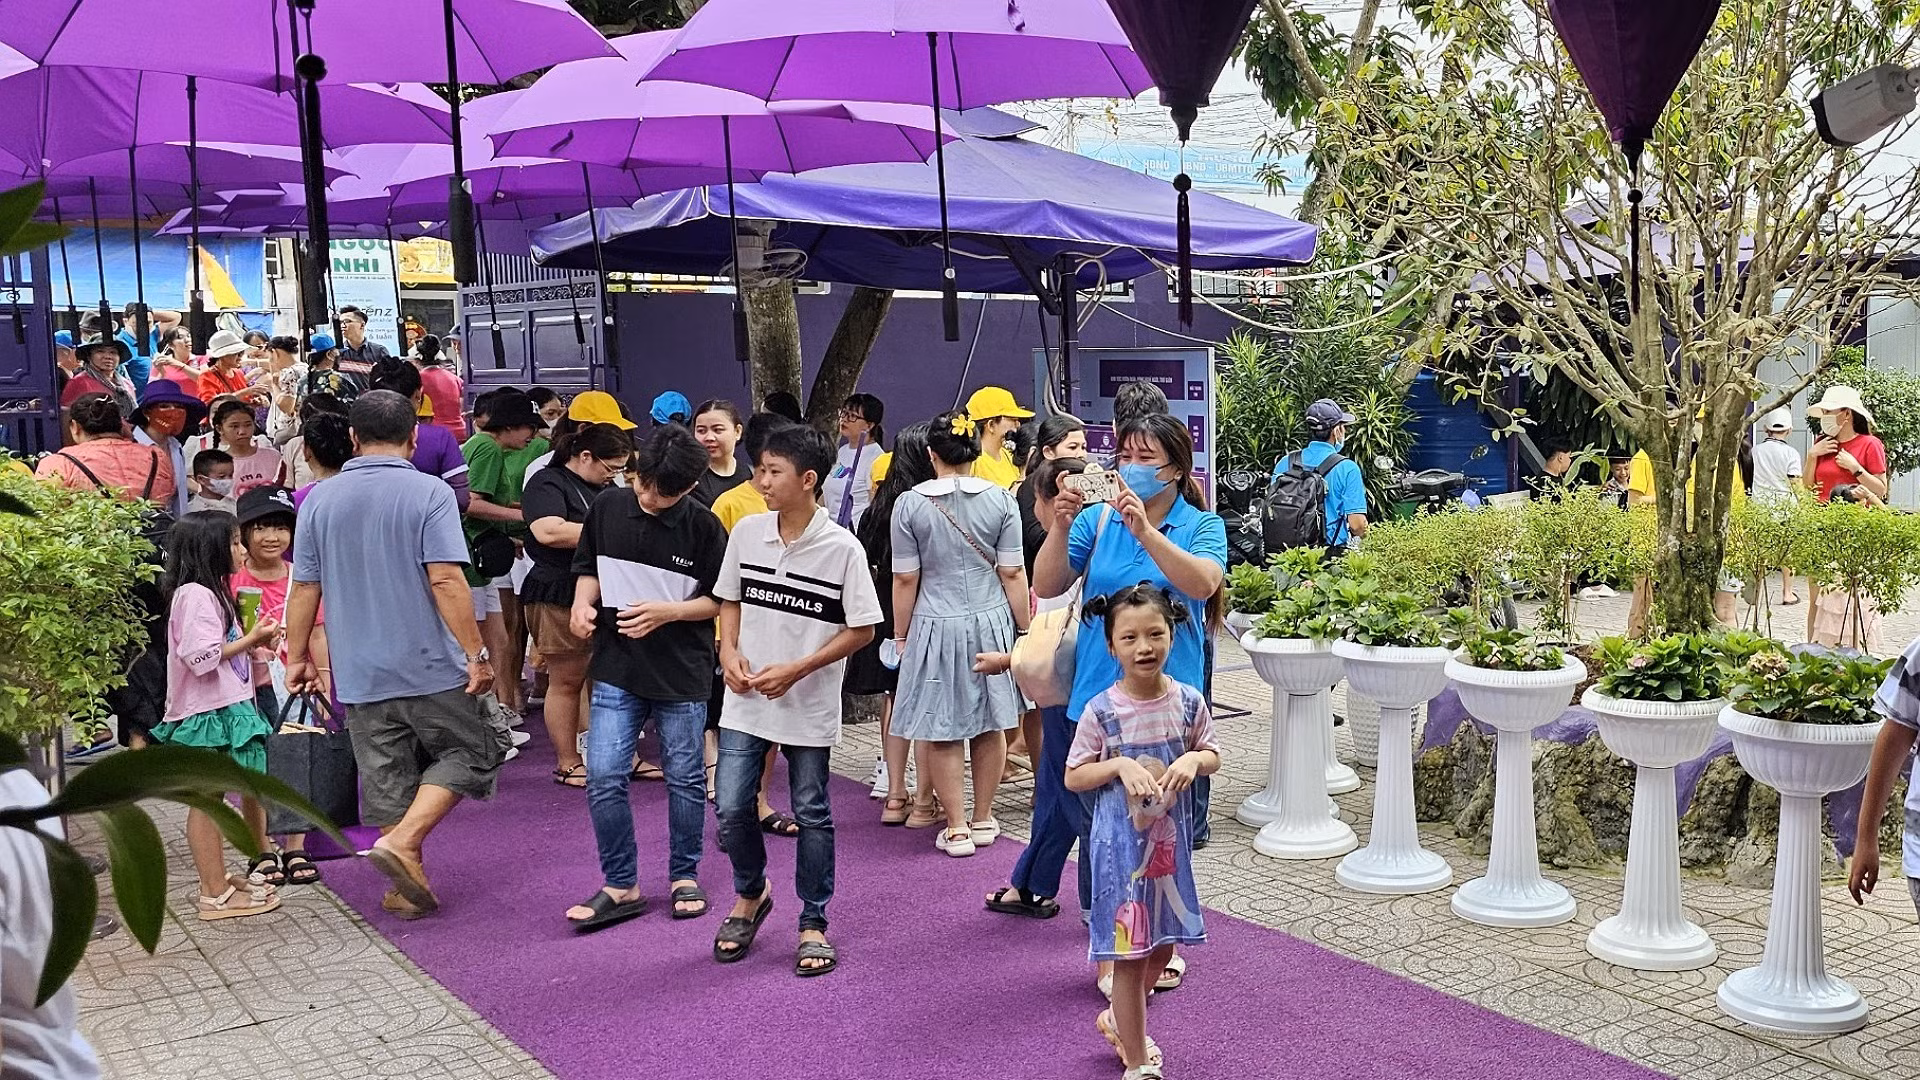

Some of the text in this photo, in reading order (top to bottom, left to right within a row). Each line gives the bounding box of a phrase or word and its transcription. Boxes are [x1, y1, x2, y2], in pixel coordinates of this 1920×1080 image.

[1184, 161, 1207, 172] BND
[333, 257, 380, 273] NHI
[190, 651, 212, 666] LOVE
